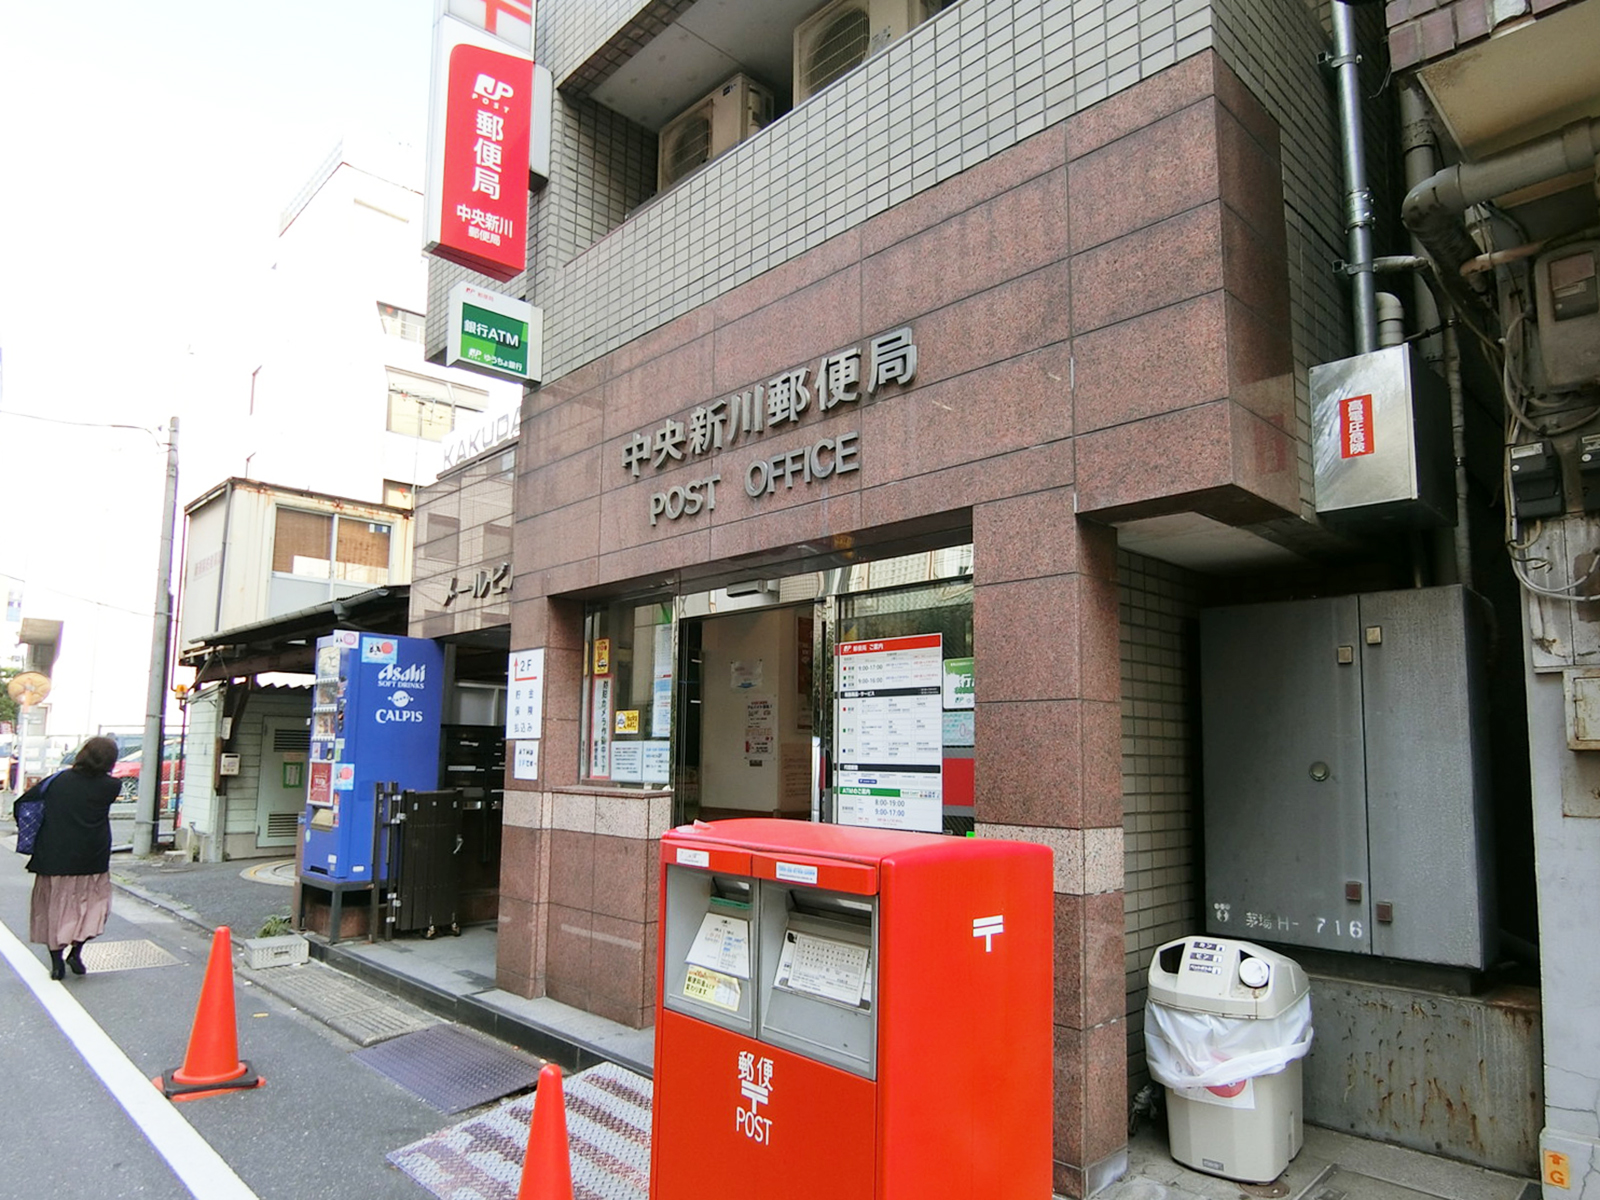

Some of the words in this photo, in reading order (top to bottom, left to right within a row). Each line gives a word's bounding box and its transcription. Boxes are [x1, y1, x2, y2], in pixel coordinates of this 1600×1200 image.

[472, 93, 509, 113] POST
[472, 109, 504, 200] 郵便局
[456, 204, 513, 238] 中央新川
[468, 225, 501, 246] 郵便局
[463, 319, 519, 347] 銀行ATM
[484, 353, 522, 372] ゆうちょ銀行
[621, 326, 918, 478] 中央新川郵便局
[650, 473, 721, 527] POST
[744, 431, 860, 499] OFFICE
[444, 562, 514, 607] メールビ
[378, 663, 426, 682] Asahi
[378, 680, 396, 688] SOFT
[397, 681, 424, 690] DRINKS
[375, 708, 423, 724] CALPIS
[737, 1051, 774, 1091] 郵便
[736, 1106, 773, 1145] POST
[1550, 1170, 1565, 1185] G
